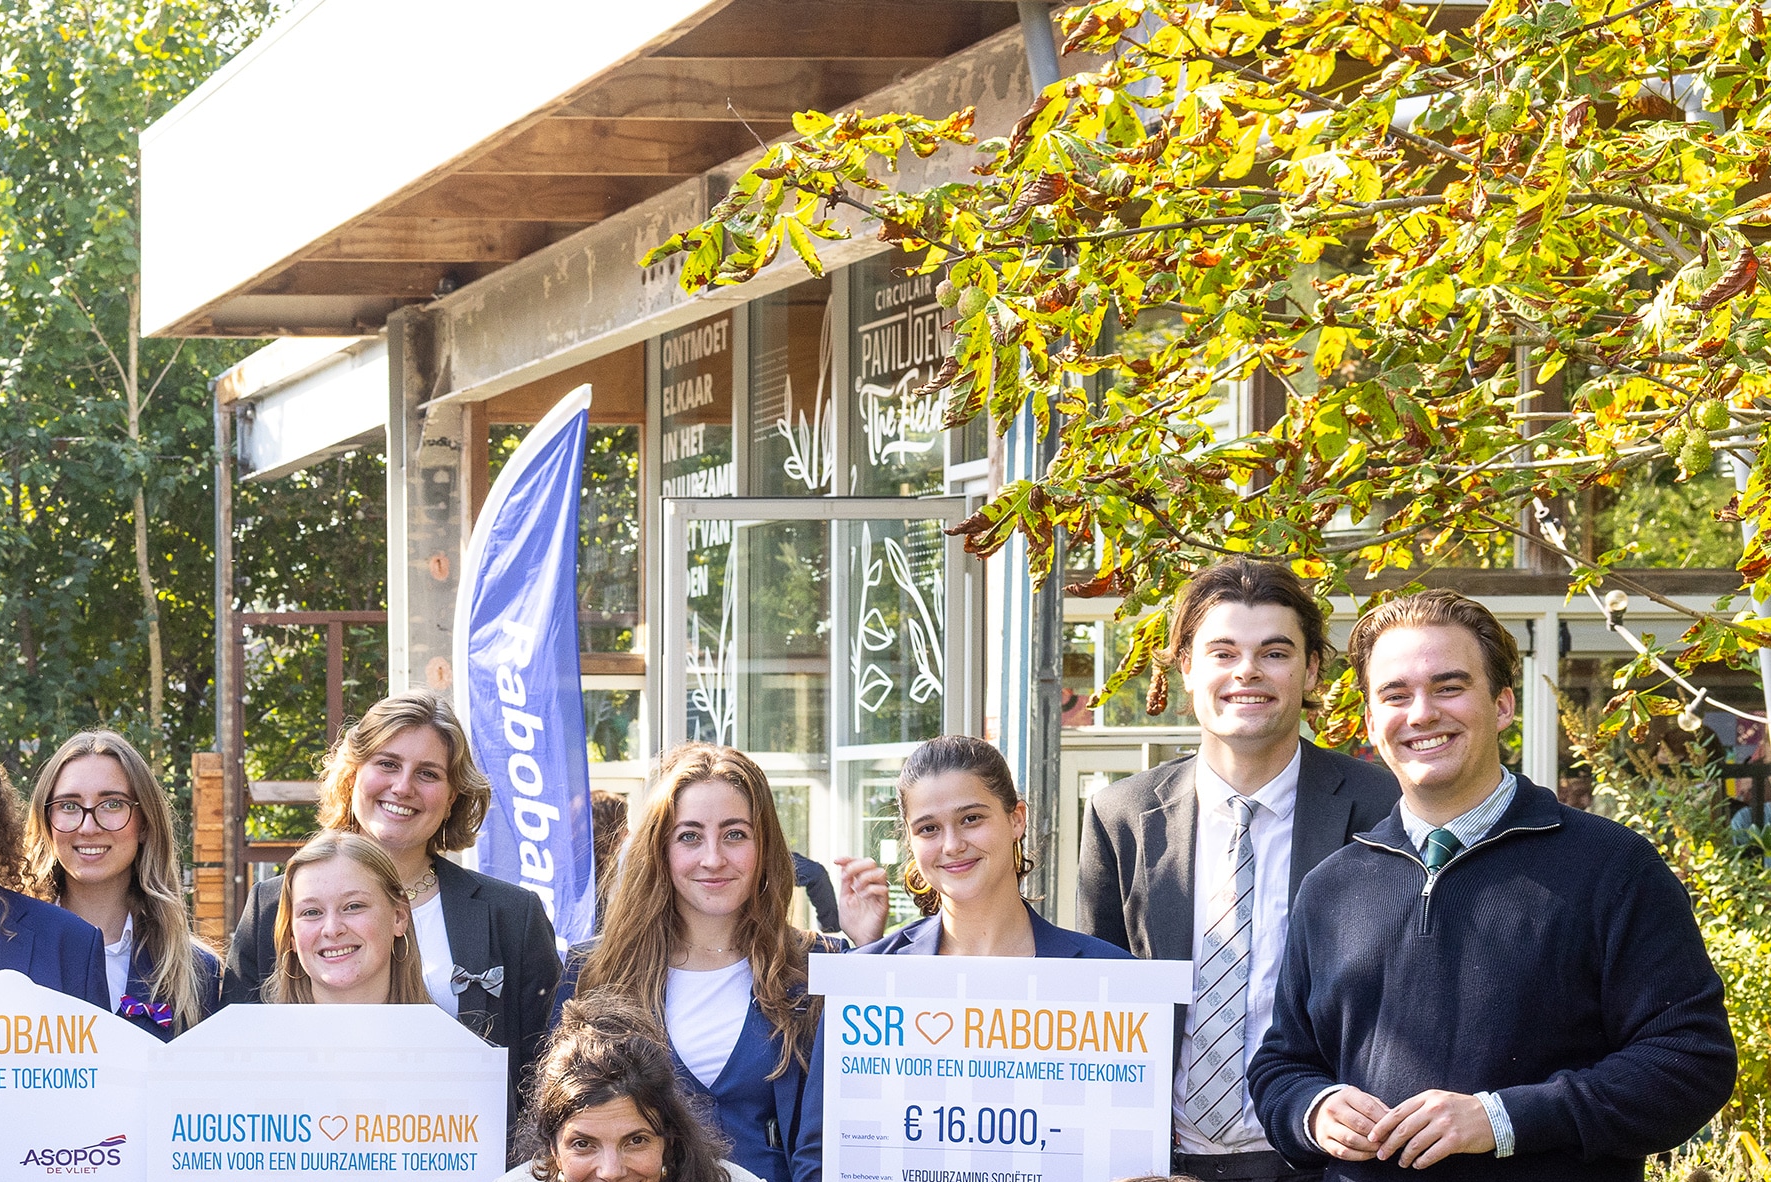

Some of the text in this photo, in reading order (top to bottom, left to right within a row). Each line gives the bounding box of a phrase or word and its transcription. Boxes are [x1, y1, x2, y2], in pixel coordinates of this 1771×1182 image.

[875, 276, 932, 311] CIRCULAIR
[663, 318, 729, 371] ONTMOET
[862, 305, 946, 379] PAVILJOEN
[663, 373, 714, 418] ELKAAR
[663, 422, 706, 464] IN HET
[859, 383, 897, 466] The
[700, 520, 730, 548] VAN
[497, 618, 568, 952] Raboban
[842, 1004, 1149, 1053] SSR RABOBANK
[12, 1068, 98, 1089] TOEKOMST
[841, 1056, 1146, 1083] SAMEN VOOR EEN DUURZAMERE TOEKOMST
[172, 1113, 479, 1143] AUGUSTINUS RABOBANK
[851, 1133, 876, 1141] waarde
[904, 1105, 1062, 1151] € 16.000,-
[21, 1149, 121, 1166] ASOPOS
[172, 1152, 478, 1171] SAMEN VOOR EEN DUURZAMERE TOEKOMST
